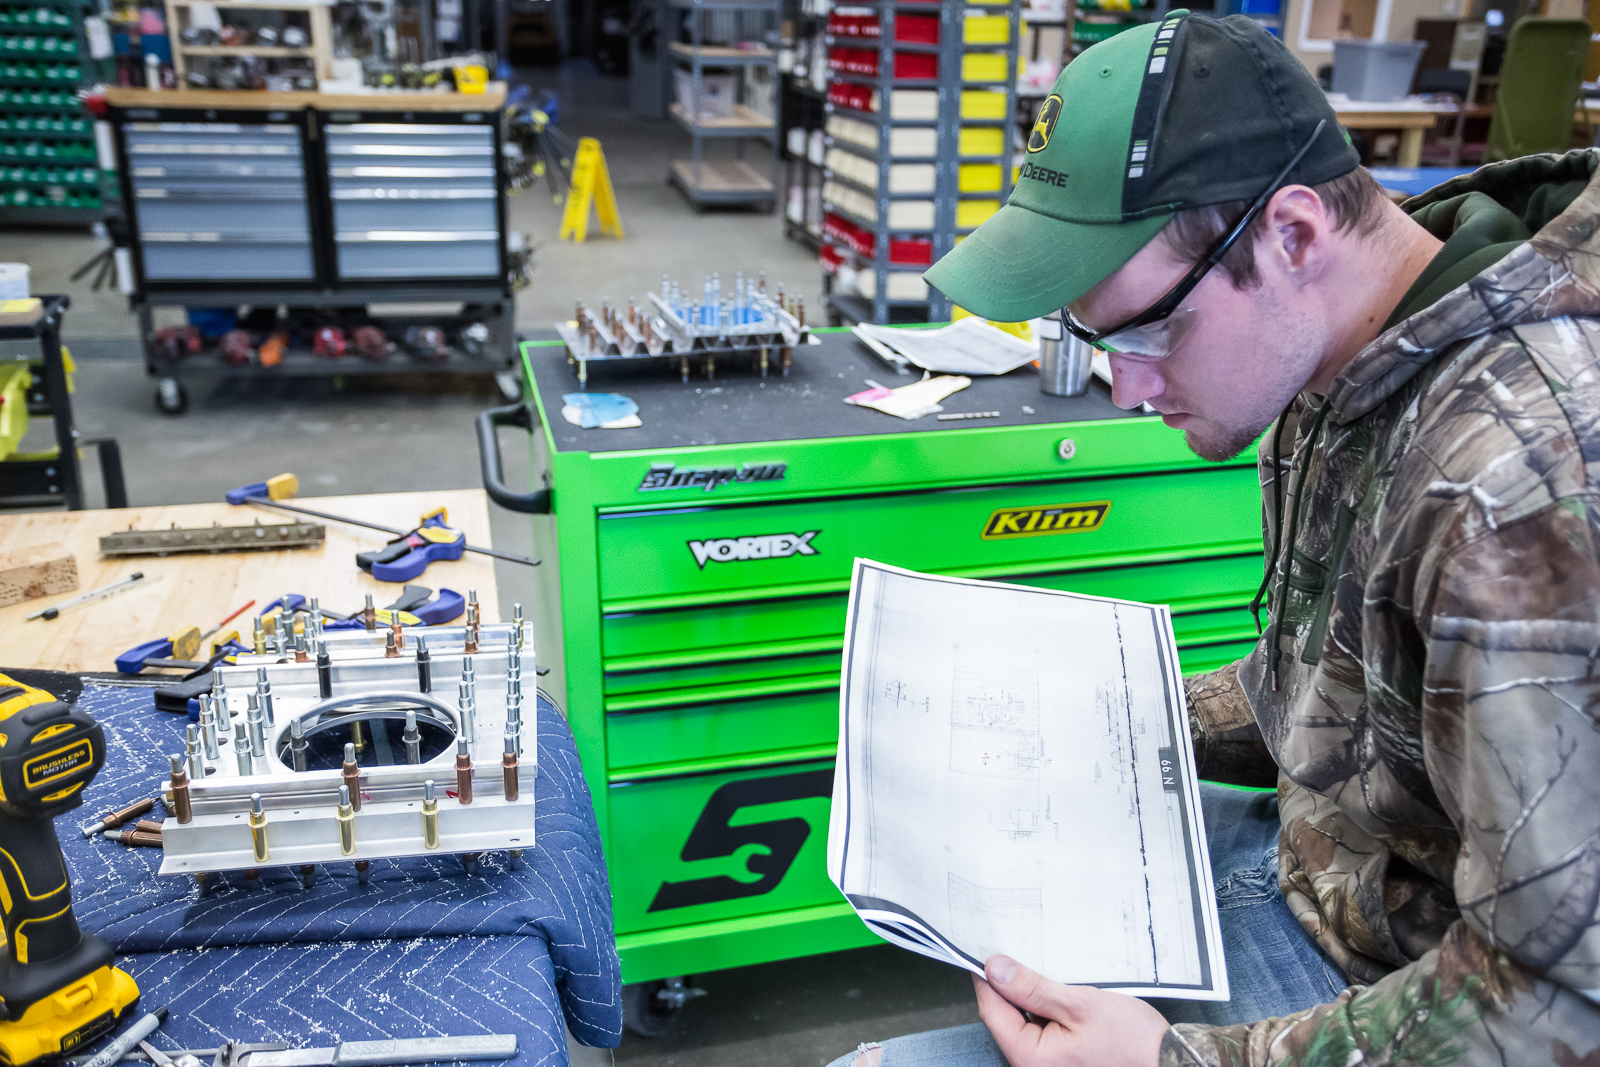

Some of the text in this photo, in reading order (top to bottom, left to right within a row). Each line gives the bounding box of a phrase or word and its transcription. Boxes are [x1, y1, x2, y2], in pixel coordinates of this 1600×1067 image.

[1024, 162, 1069, 188] DEERE
[991, 509, 1099, 534] Klim
[687, 530, 822, 570] VORTEX
[32, 749, 86, 775] BRUSHLESS
[42, 758, 78, 776] MOTOR
